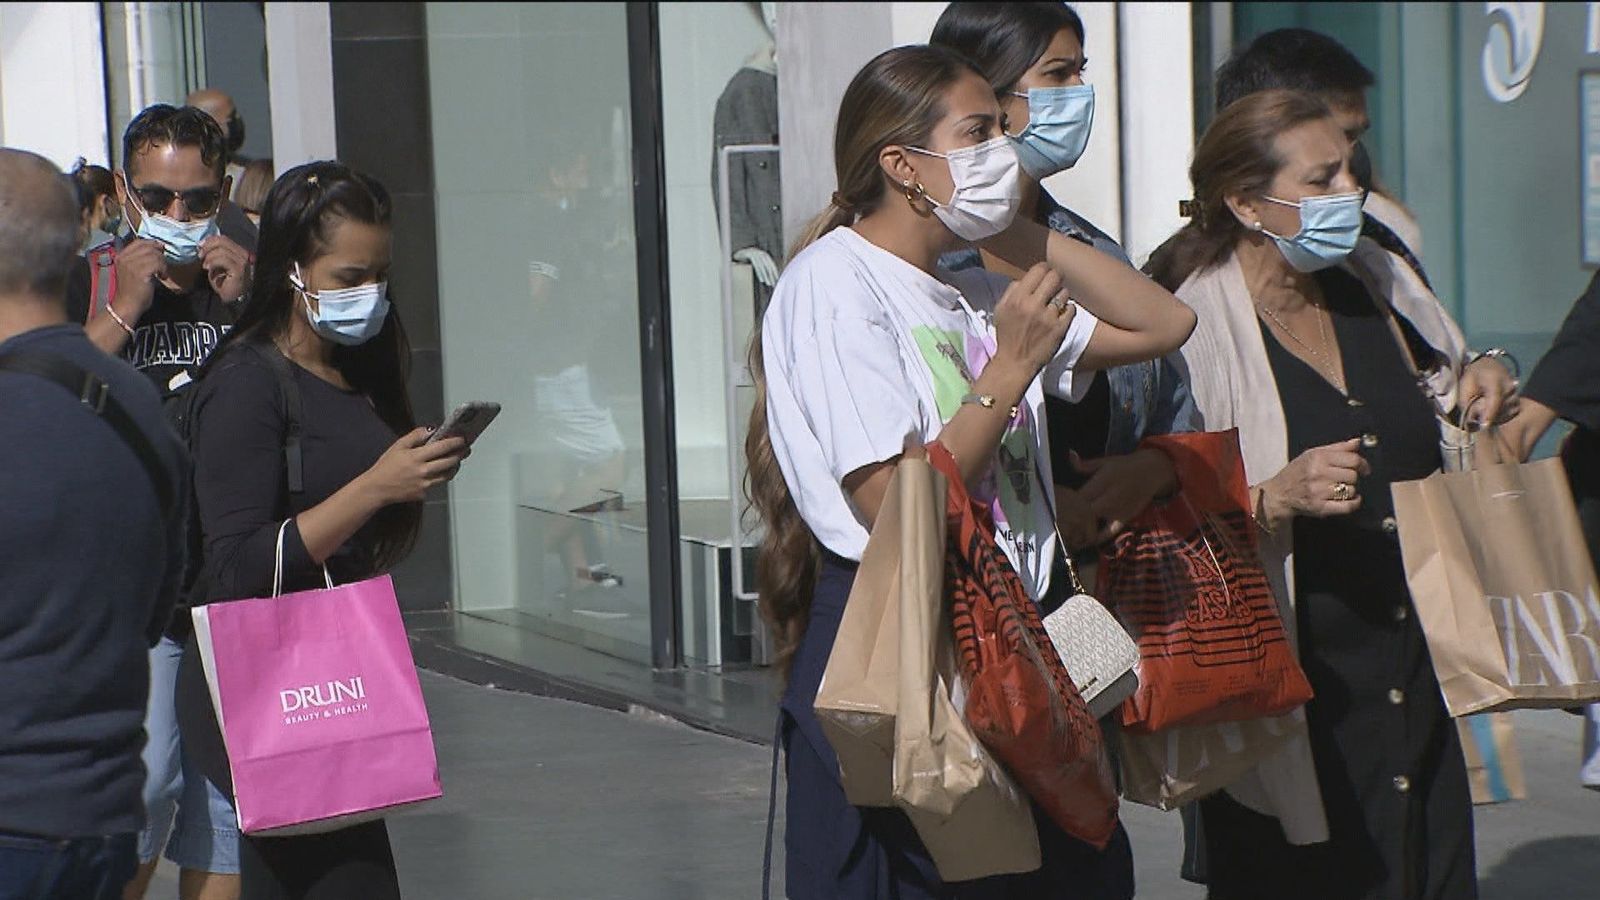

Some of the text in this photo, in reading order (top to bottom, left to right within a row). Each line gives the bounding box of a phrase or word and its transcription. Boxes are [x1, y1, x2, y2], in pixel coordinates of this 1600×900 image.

[127, 321, 232, 369] MADR
[280, 676, 366, 713] DRUNI
[284, 702, 368, 725] BEAUTY & HEALTH
